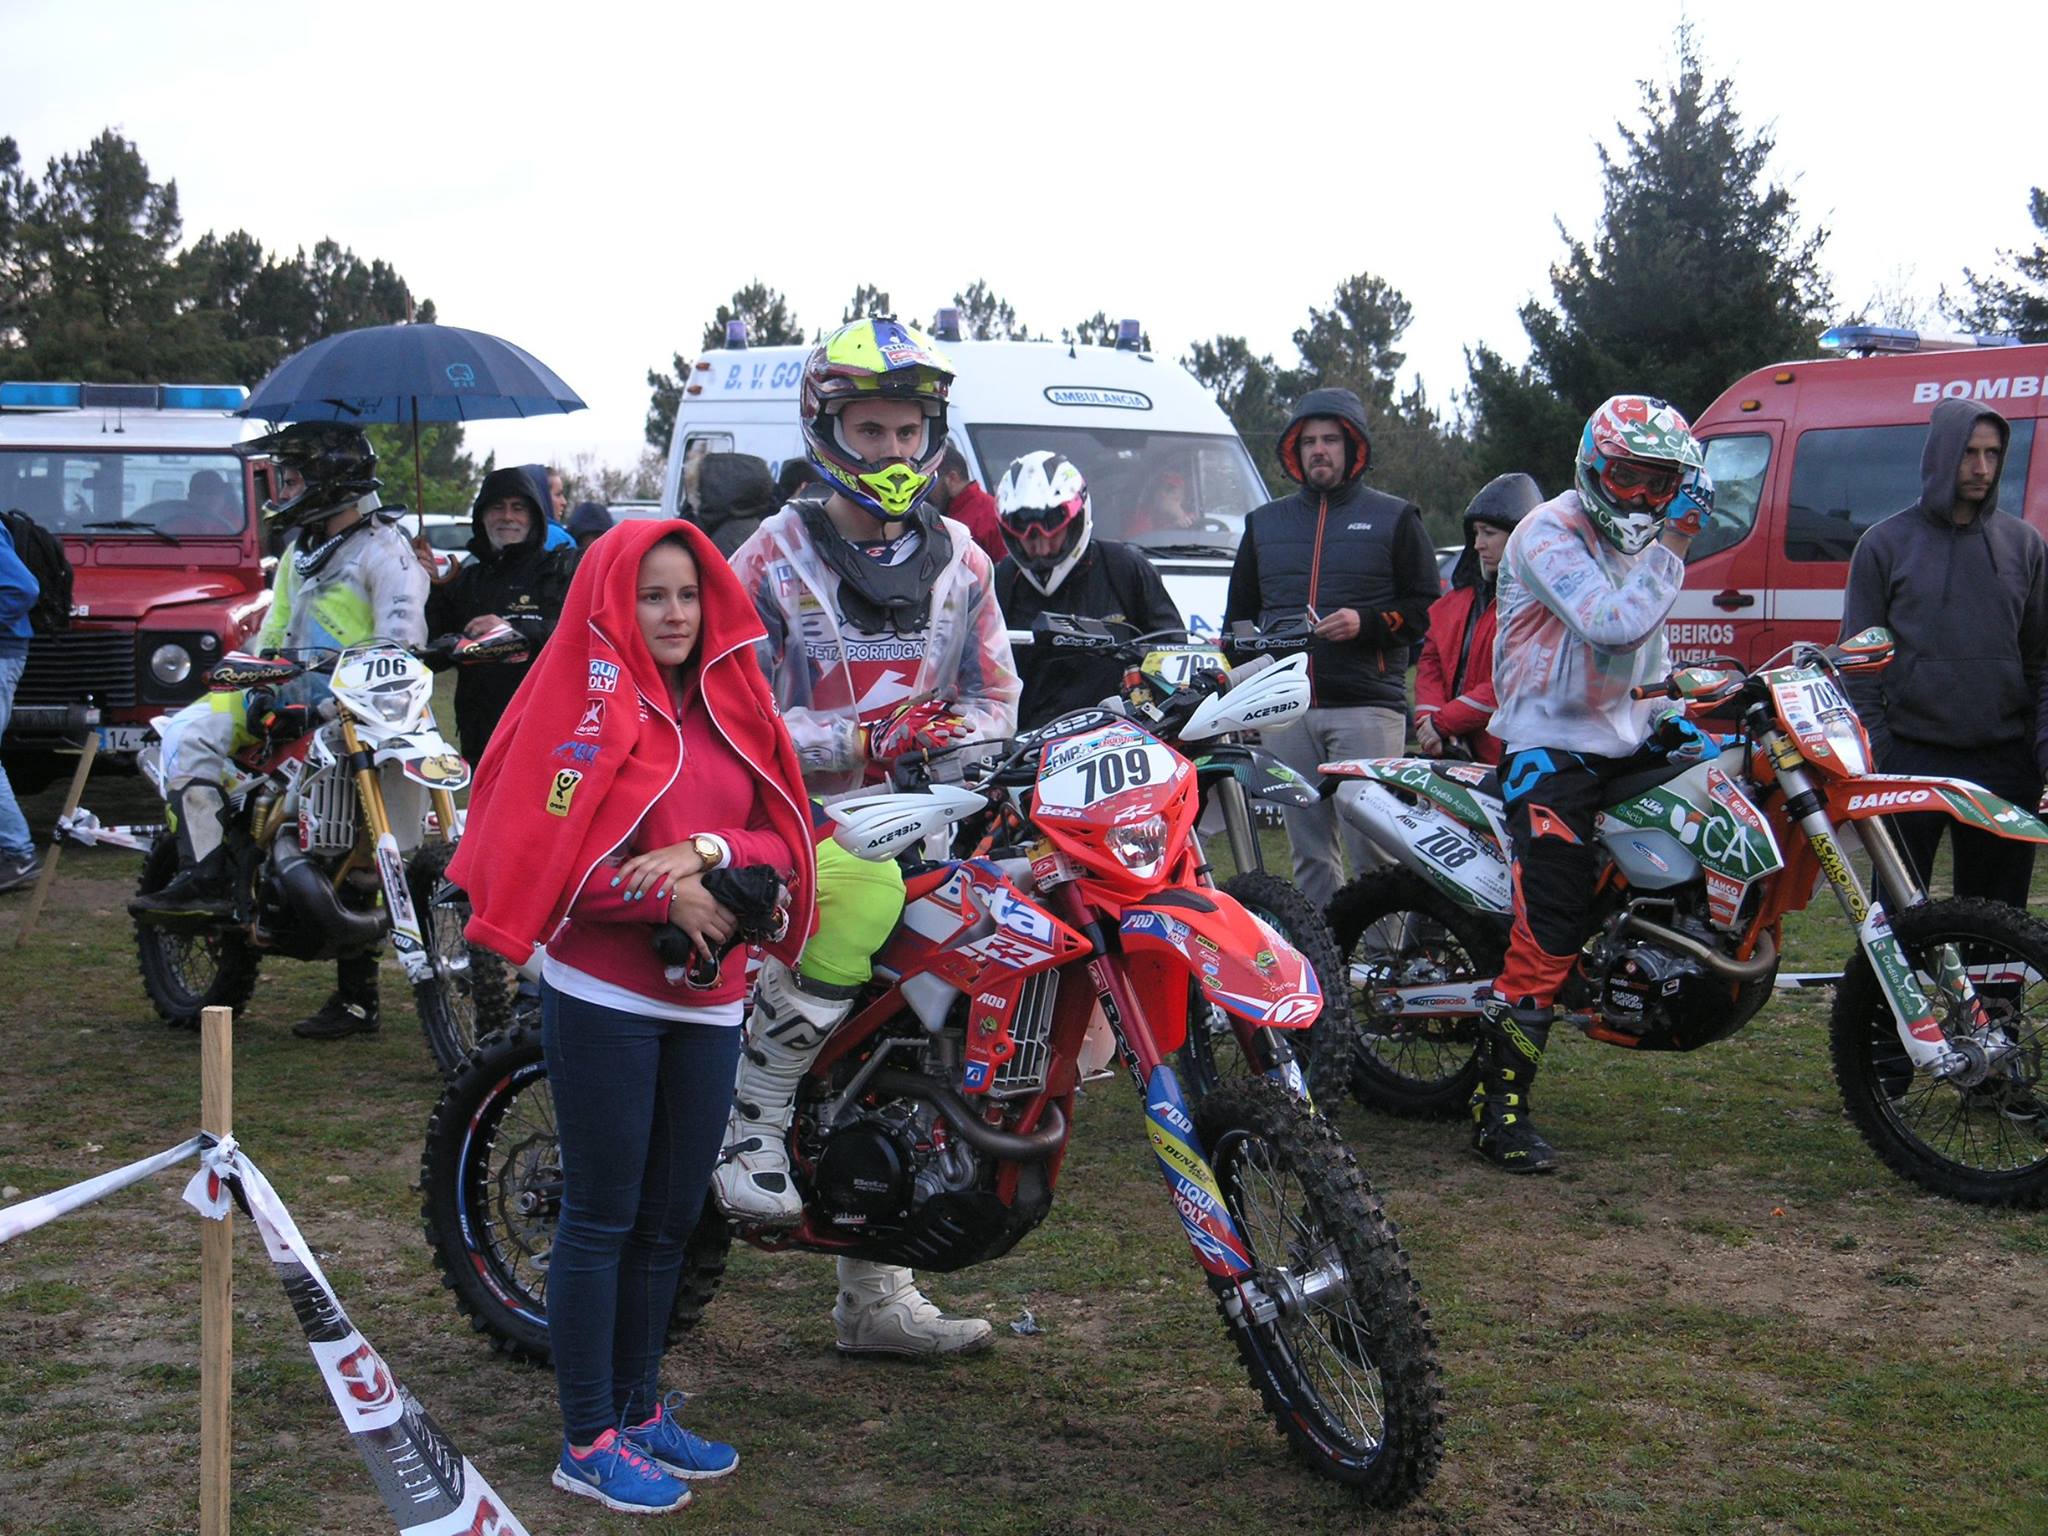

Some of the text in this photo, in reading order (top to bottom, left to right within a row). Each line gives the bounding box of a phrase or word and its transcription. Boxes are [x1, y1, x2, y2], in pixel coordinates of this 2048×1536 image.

[724, 364, 742, 390] B.
[750, 363, 767, 390] V.
[1598, 510, 1617, 537] CA
[1188, 613, 1223, 633] A
[362, 658, 407, 682] 706
[1242, 700, 1301, 722] ACERBIS
[1051, 747, 1081, 768] FMP
[1077, 748, 1151, 806] 709
[1400, 768, 1430, 790] CA
[1036, 805, 1082, 818] Beta
[1638, 797, 1665, 815] KTM
[1847, 788, 1932, 811] BAHCO
[867, 821, 922, 849] ACERBIS
[1413, 826, 1479, 869] 708
[1702, 815, 1751, 874] CA
[1708, 876, 1739, 898] BAHCO
[1903, 973, 1928, 1015] CA
[1172, 1191, 1210, 1226] MOLY
[386, 1437, 441, 1504] METAL
